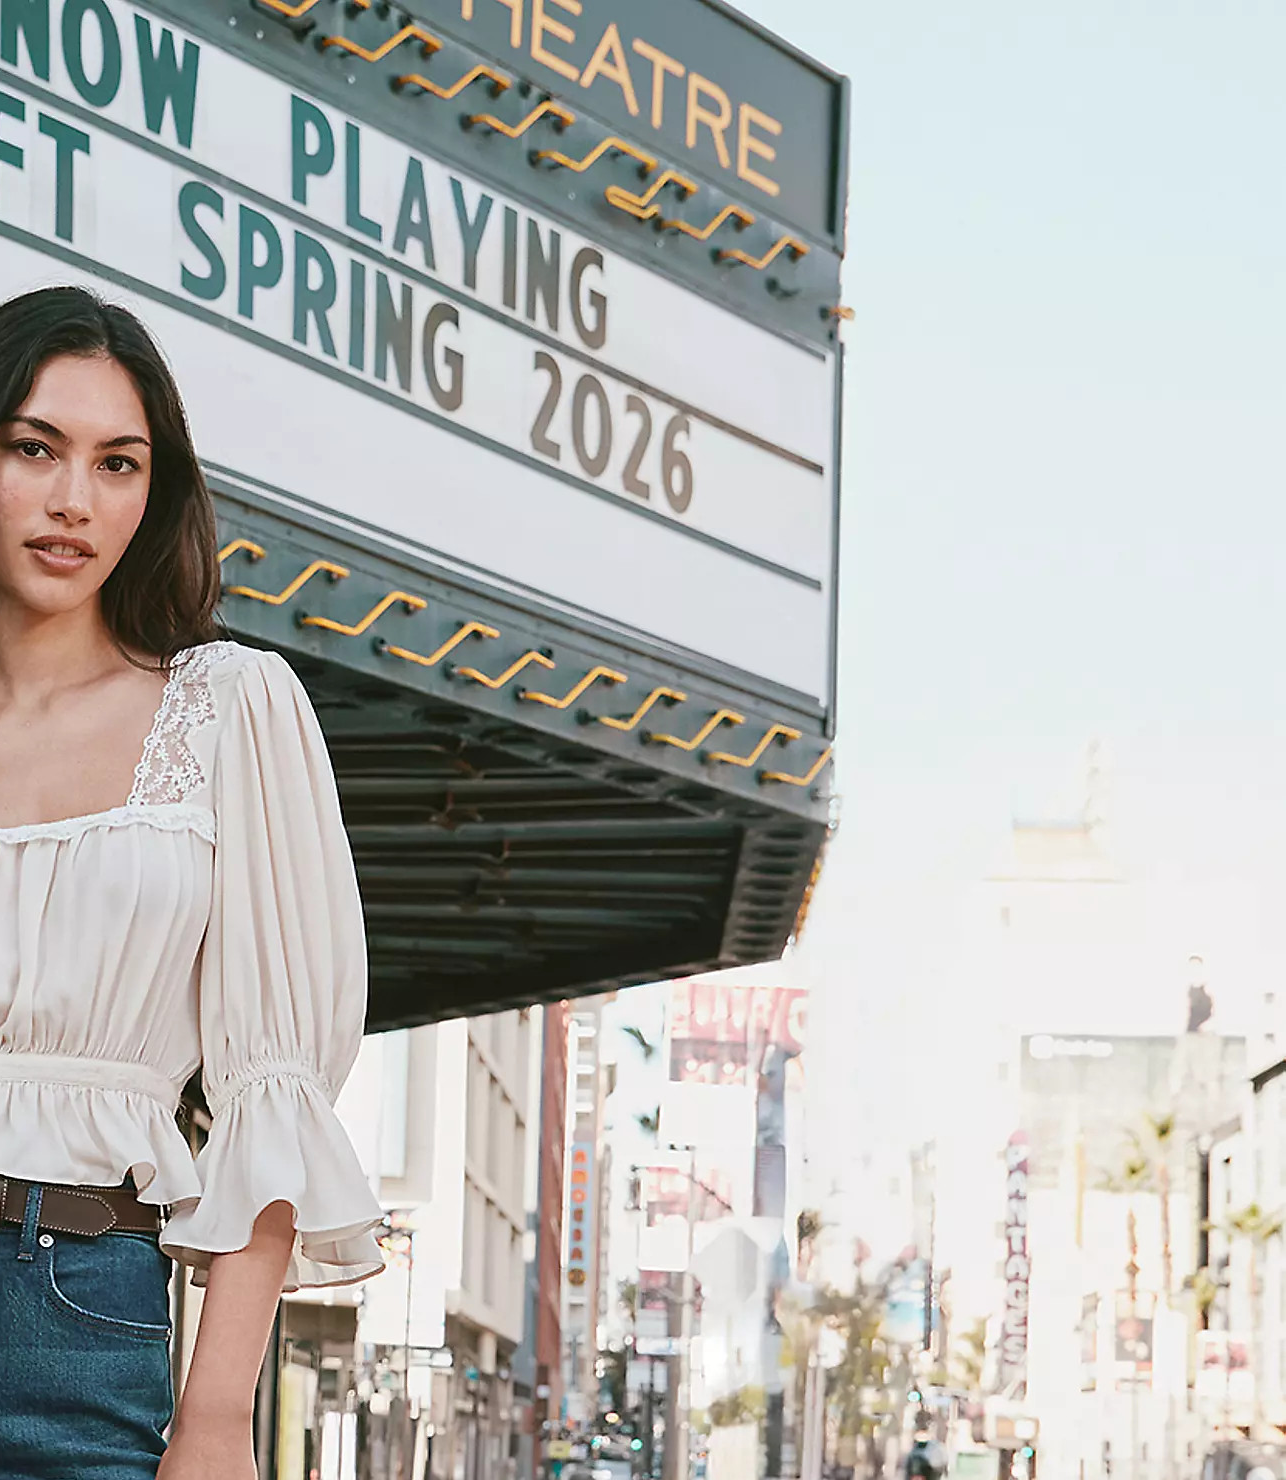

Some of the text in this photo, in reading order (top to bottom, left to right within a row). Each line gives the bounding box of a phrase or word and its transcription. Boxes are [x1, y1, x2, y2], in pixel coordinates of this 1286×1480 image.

[0, 0, 609, 350] NOW PLAYING
[177, 180, 465, 412] SPRING
[529, 350, 694, 514] 2026
